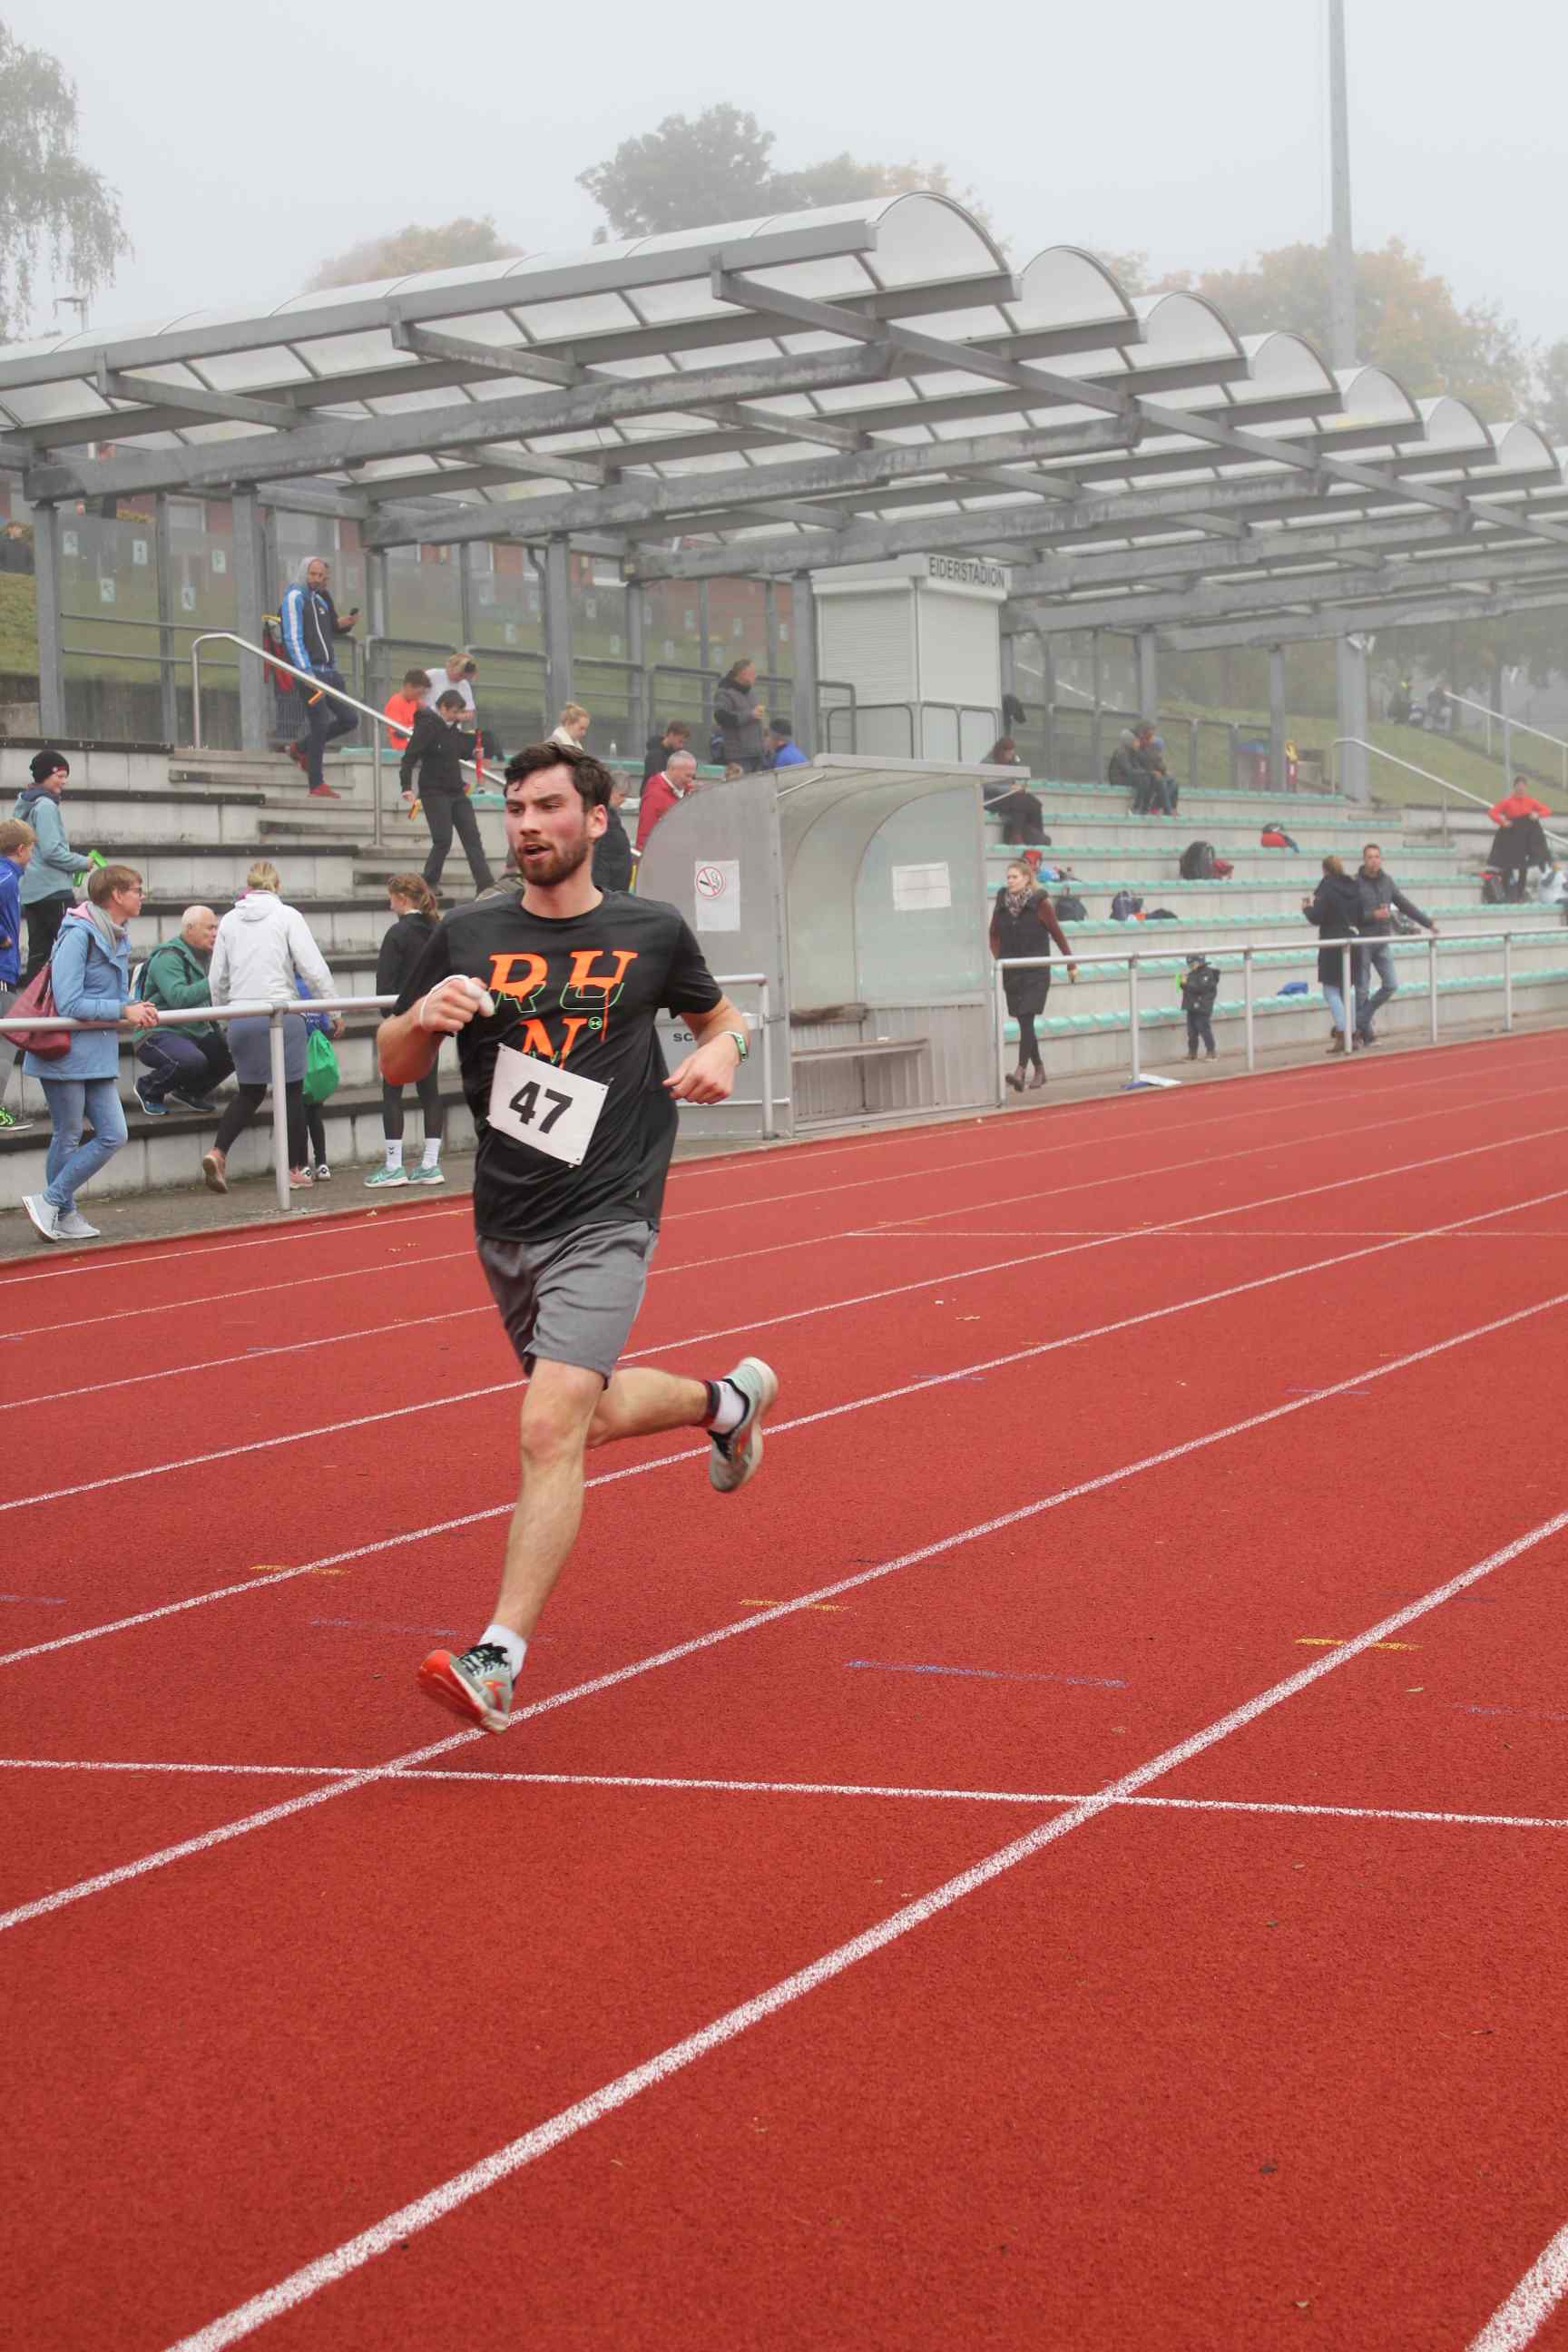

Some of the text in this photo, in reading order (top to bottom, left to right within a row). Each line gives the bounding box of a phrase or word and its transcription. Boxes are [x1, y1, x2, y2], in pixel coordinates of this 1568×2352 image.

[928, 555, 1006, 589] EIDERSTADION
[672, 1031, 696, 1043] SC
[508, 1080, 573, 1135] 47
